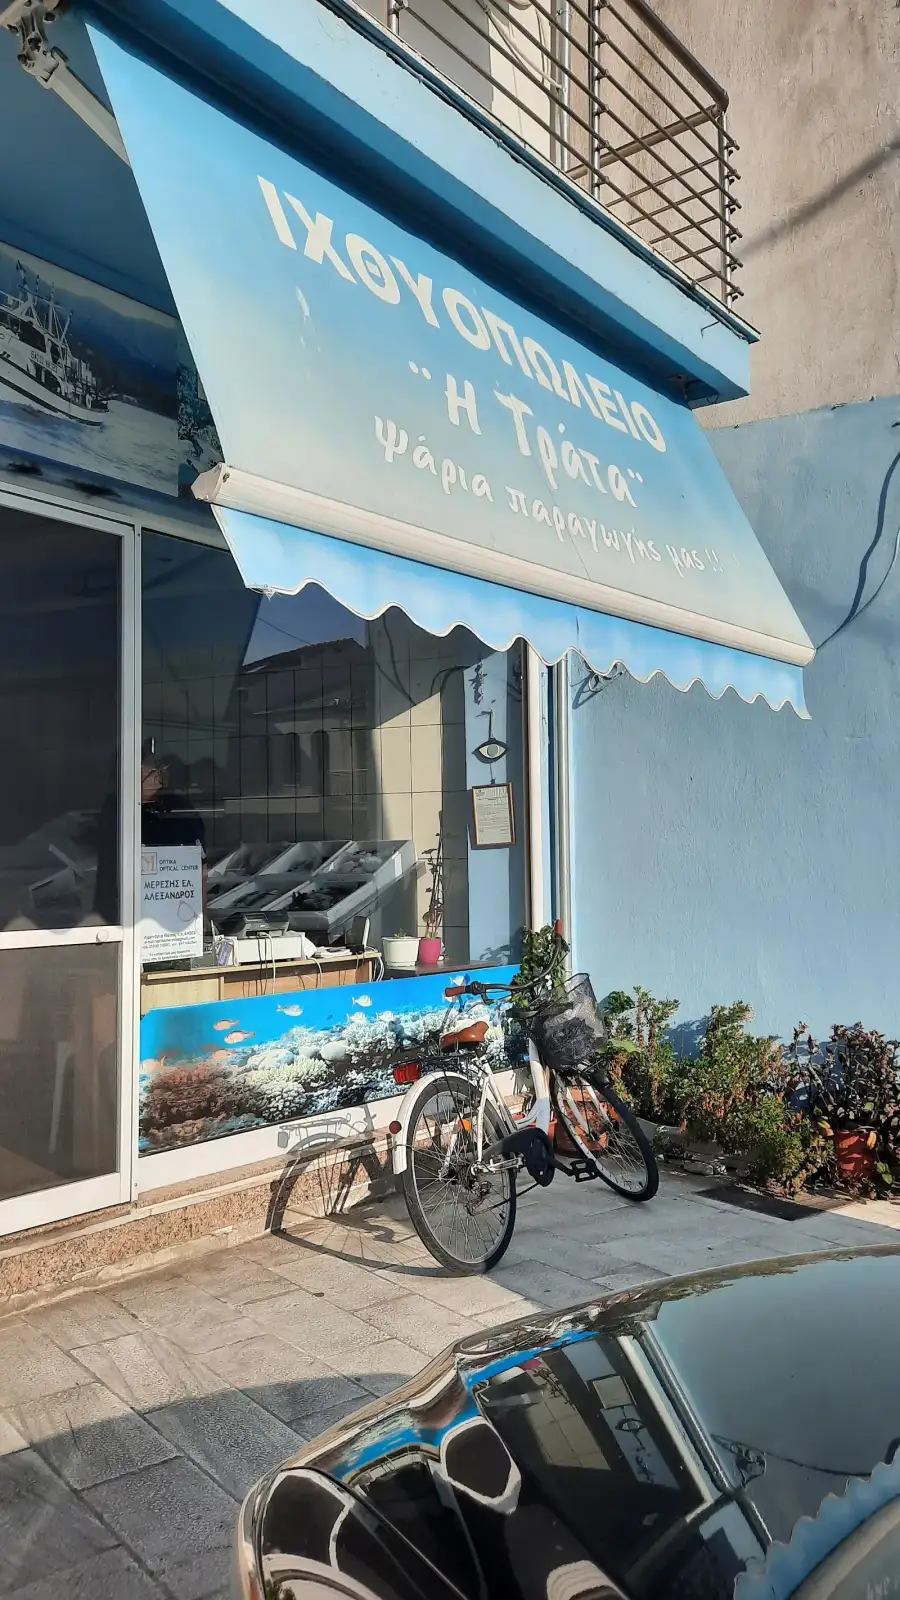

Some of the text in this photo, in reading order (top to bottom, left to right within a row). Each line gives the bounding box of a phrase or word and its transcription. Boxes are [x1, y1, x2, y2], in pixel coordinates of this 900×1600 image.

[257, 175, 666, 452] ΙΧΘΥΟΠΩΛΕΙΟ
[505, 486, 662, 564] παραγωγής
[144, 880, 180, 889] ΜΕΡΕΣΗΣ
[144, 890, 195, 901] ΑΛΕΞΑΝΔΡΟΣ
